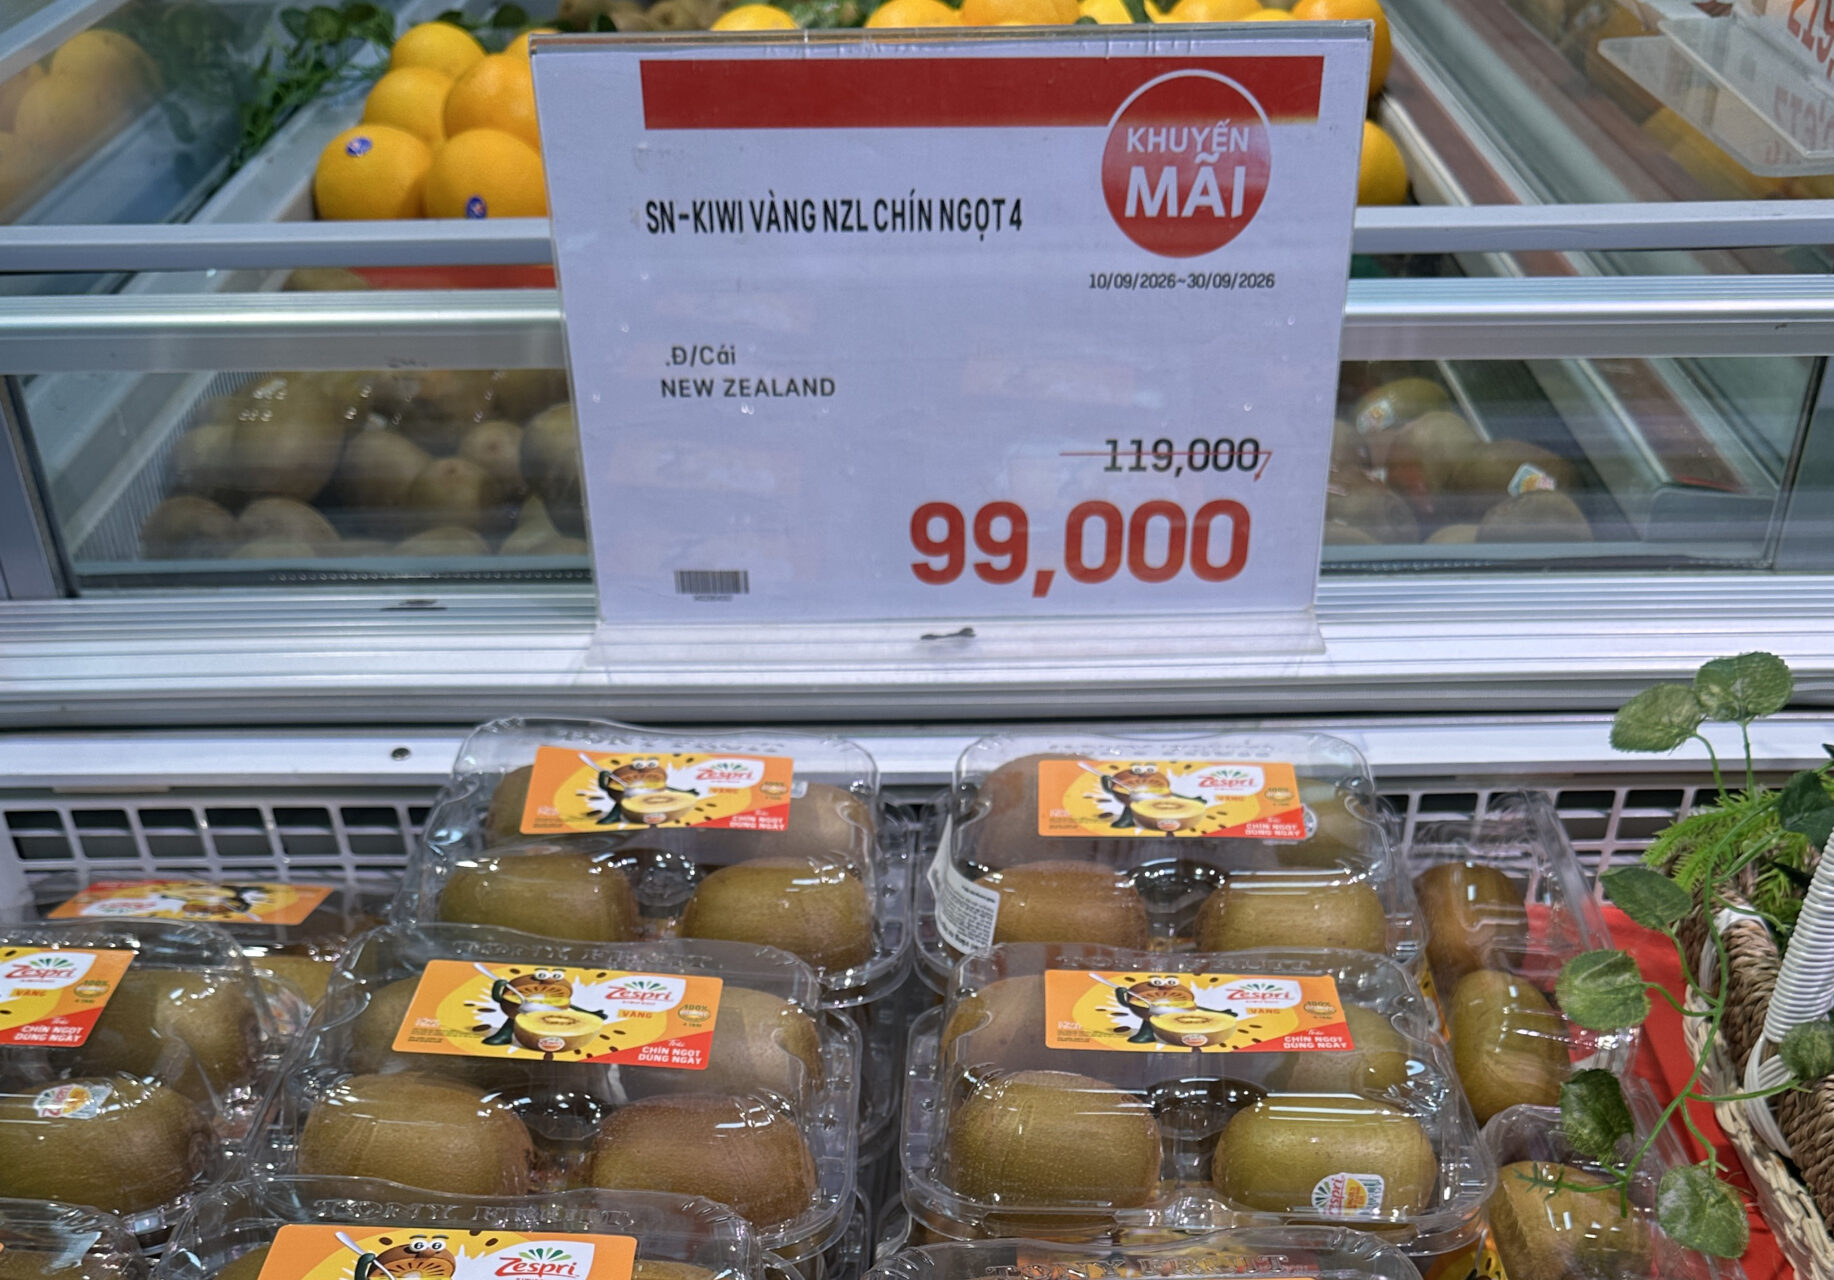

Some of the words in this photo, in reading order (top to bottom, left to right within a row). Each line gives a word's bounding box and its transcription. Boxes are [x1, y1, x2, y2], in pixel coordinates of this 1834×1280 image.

[1126, 118, 1250, 153] KHUYẾN
[1124, 151, 1247, 219] MÃI
[646, 199, 744, 234] SN-KIWI
[750, 190, 817, 233] VÀNG
[823, 198, 868, 232] NZL
[873, 189, 932, 232] CHÍN
[940, 198, 1004, 242] NGỌT
[1009, 198, 1023, 232] 4
[661, 378, 714, 398] NEW
[723, 377, 836, 397] ZEALAND
[1103, 437, 1261, 479] 119,000
[909, 498, 1252, 598] 99,000
[605, 985, 674, 1002] Zespri
[1225, 988, 1295, 1001] Zespri
[494, 1256, 580, 1279] Zespri
